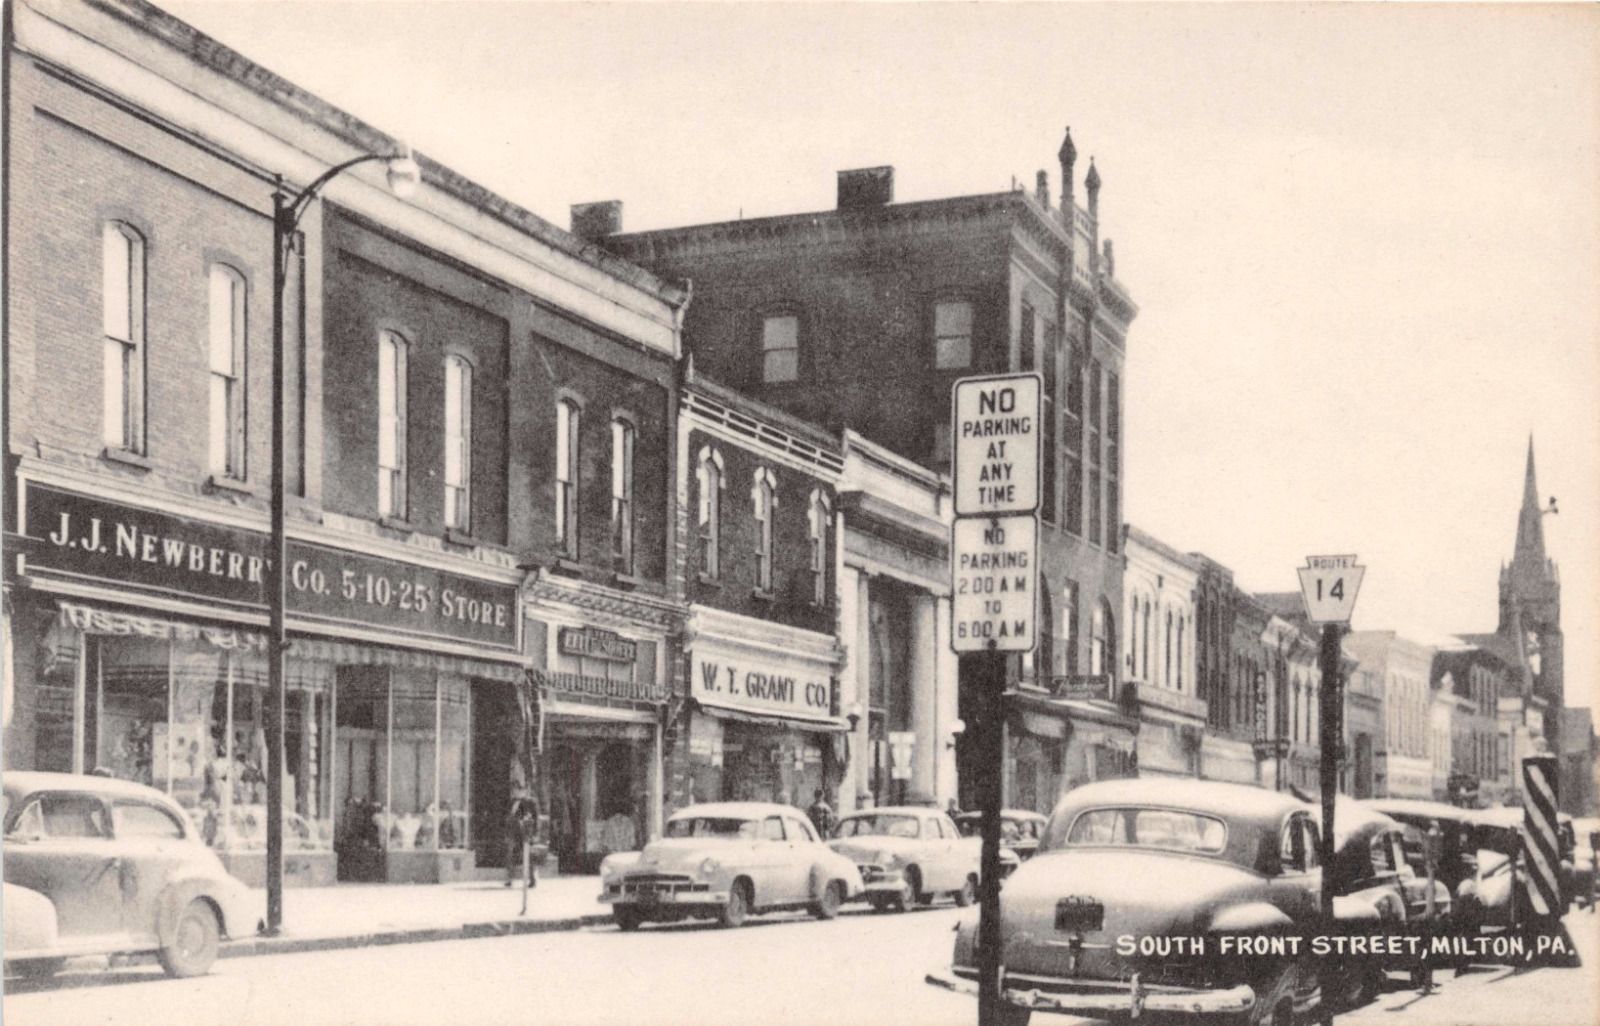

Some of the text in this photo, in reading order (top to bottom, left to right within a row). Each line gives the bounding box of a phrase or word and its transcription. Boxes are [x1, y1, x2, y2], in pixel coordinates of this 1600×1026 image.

[979, 387, 1015, 415] NO
[962, 416, 1031, 438] PARKING
[986, 440, 1006, 459] AT
[979, 463, 1013, 482] ANY
[978, 484, 1015, 504] TIME
[983, 527, 1005, 545] NO
[960, 551, 1028, 570] PARKING
[1313, 558, 1347, 568] ROUTE
[1316, 577, 1343, 601] 14
[441, 588, 506, 627] STORE
[984, 600, 1002, 614] TO
[701, 661, 829, 708] W. T. GRANT CO.
